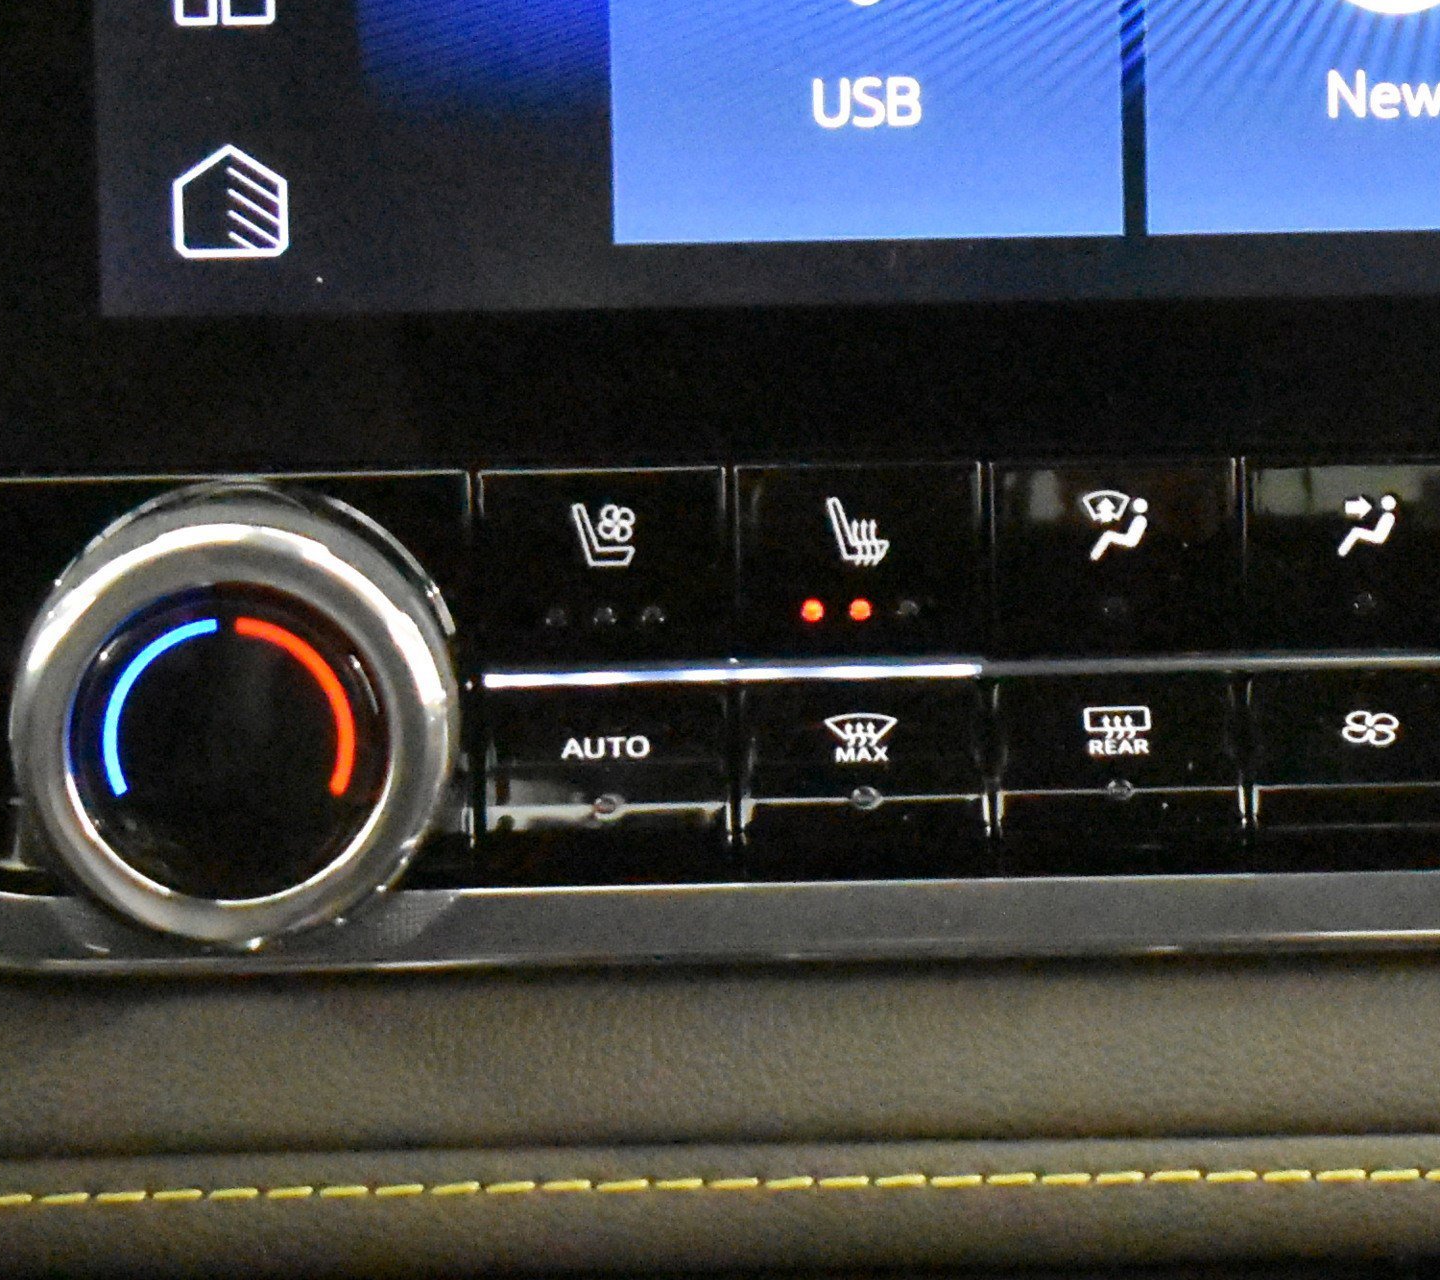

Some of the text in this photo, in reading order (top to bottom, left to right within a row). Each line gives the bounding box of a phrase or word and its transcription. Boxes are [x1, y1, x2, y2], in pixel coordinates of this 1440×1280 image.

[812, 76, 922, 129] USB
[560, 735, 651, 760] AUTO
[834, 746, 890, 763] MAX
[1087, 737, 1150, 756] REAR
